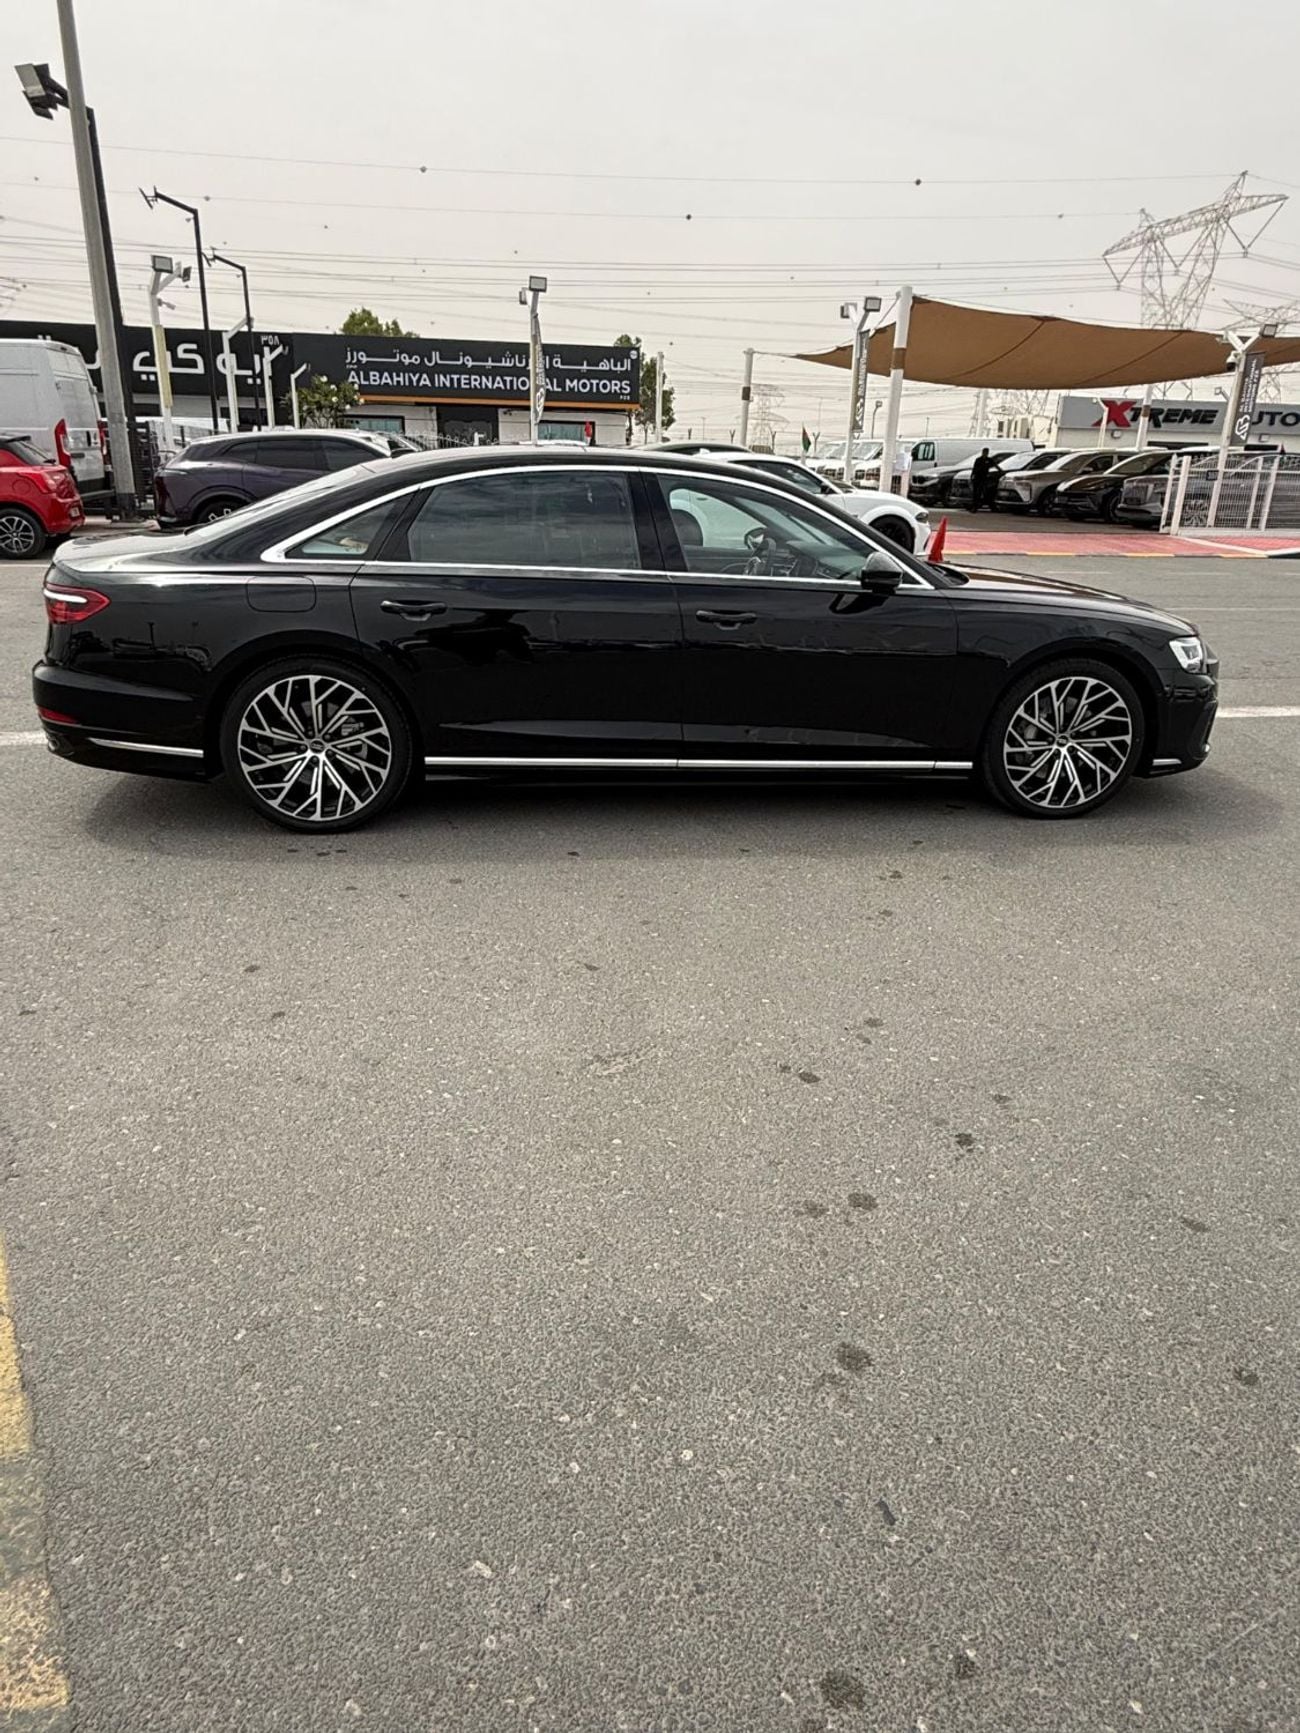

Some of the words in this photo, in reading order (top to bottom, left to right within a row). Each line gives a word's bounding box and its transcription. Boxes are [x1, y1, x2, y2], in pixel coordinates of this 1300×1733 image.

[345, 347, 421, 365] موتورز
[347, 370, 432, 387] ALBAHIYA
[434, 373, 562, 392] INTERNATIOAL
[565, 378, 631, 394] MOTORS
[1092, 399, 1219, 428] XTREME
